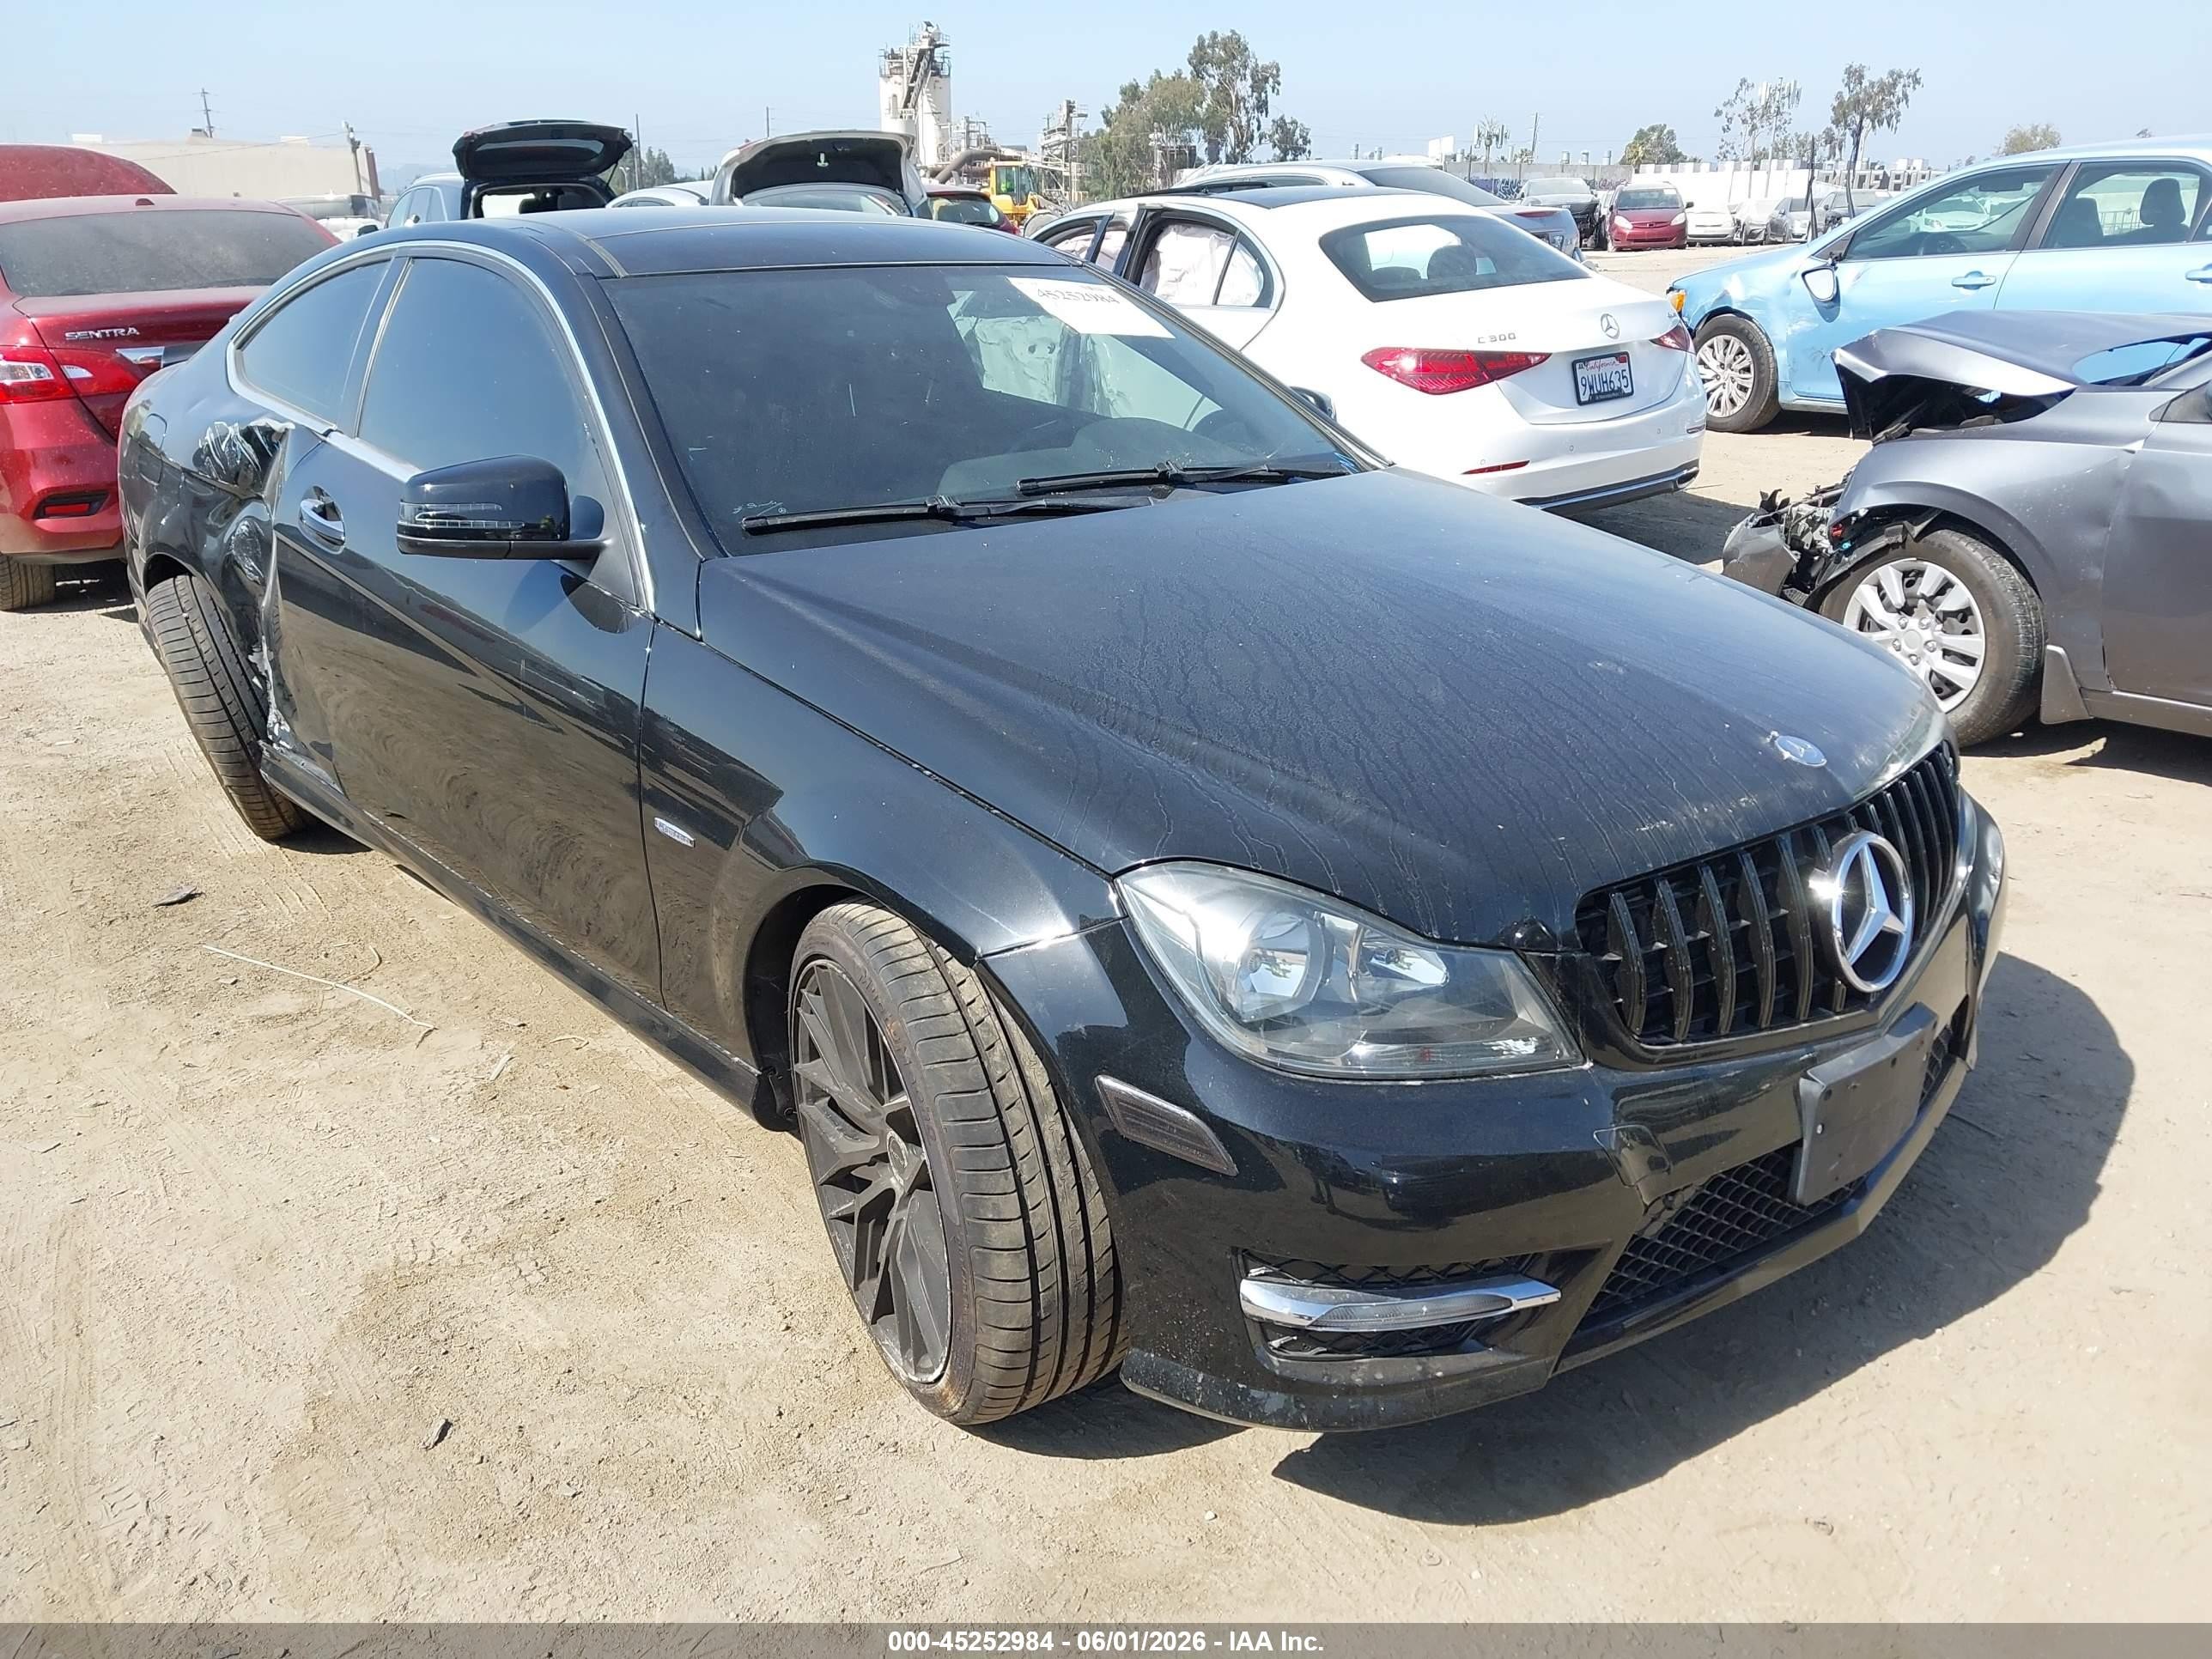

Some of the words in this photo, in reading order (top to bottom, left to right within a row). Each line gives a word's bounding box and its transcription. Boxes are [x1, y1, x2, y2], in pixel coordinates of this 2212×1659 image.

[65, 326, 140, 341] SENTRA
[1489, 332, 1516, 343] 300
[1584, 359, 1617, 371] California
[1580, 368, 1629, 396] 9WUH635
